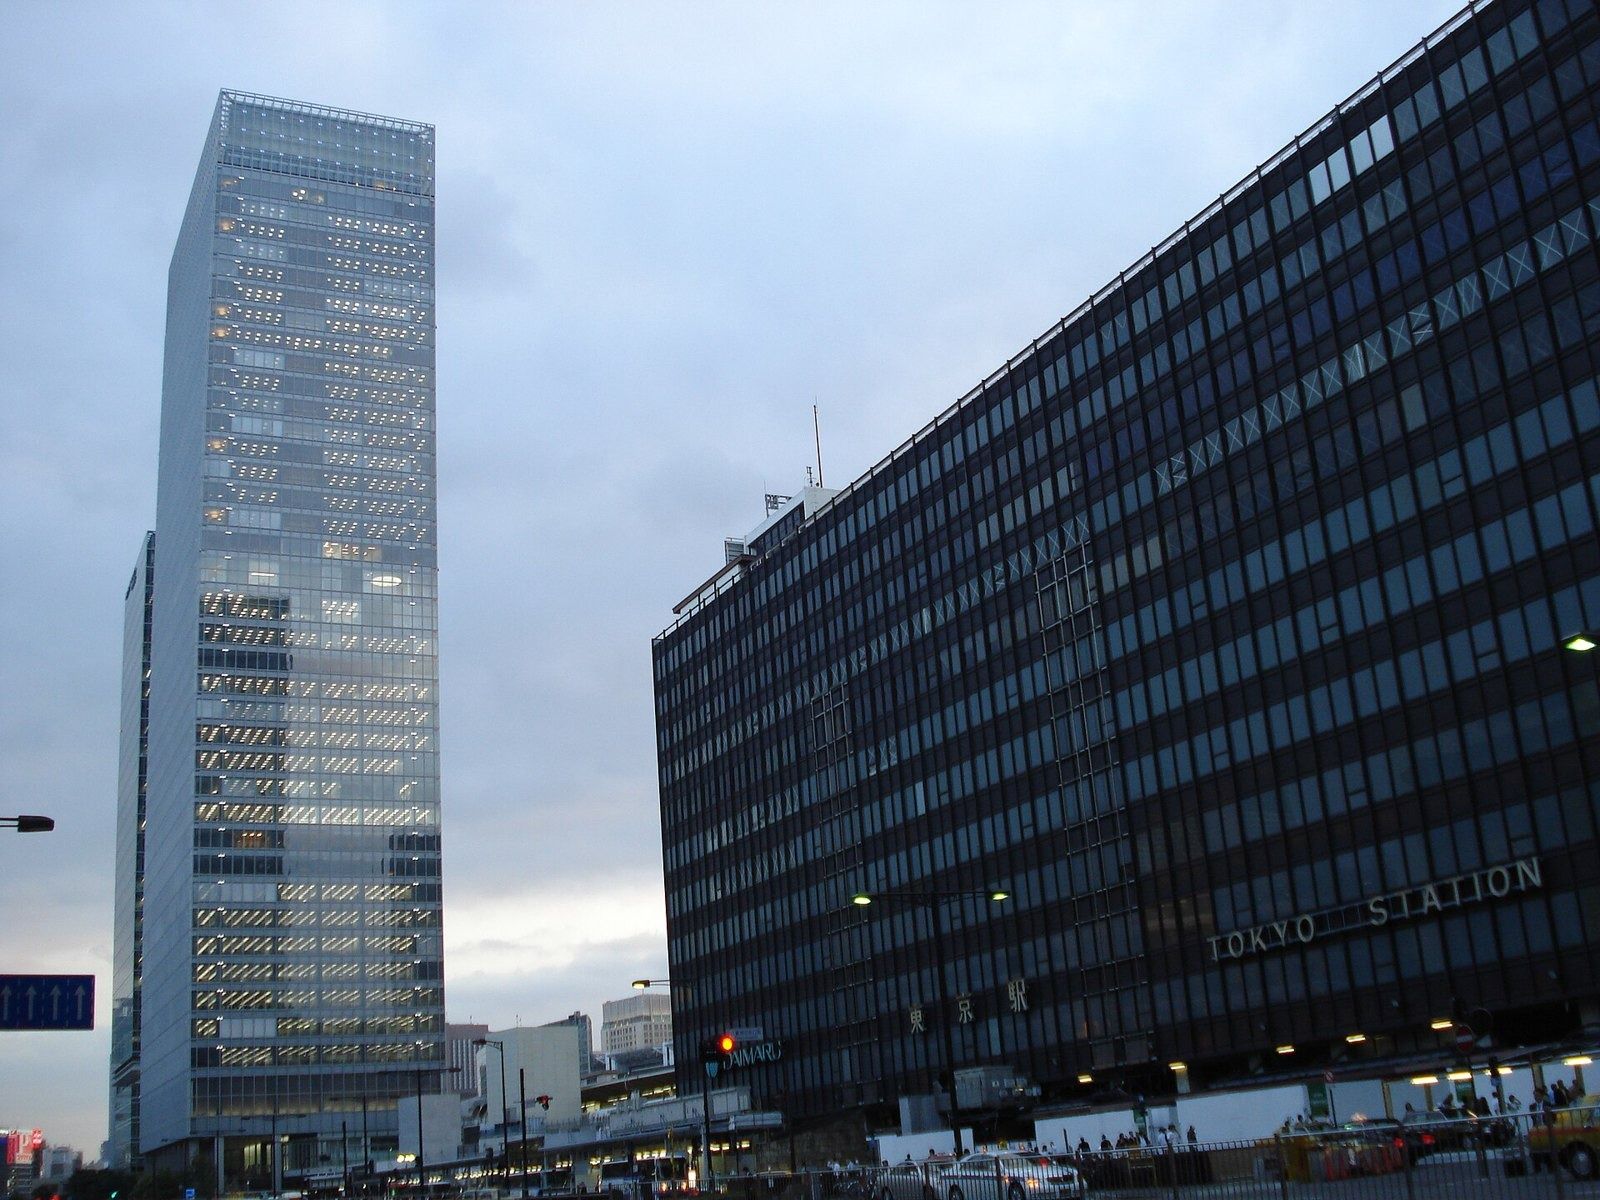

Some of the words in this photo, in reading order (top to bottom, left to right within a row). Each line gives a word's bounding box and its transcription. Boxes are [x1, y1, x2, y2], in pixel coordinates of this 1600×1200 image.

[1207, 914, 1315, 961] TOKYO
[1369, 857, 1543, 926] STATION
[908, 976, 1029, 1035] 東京駅
